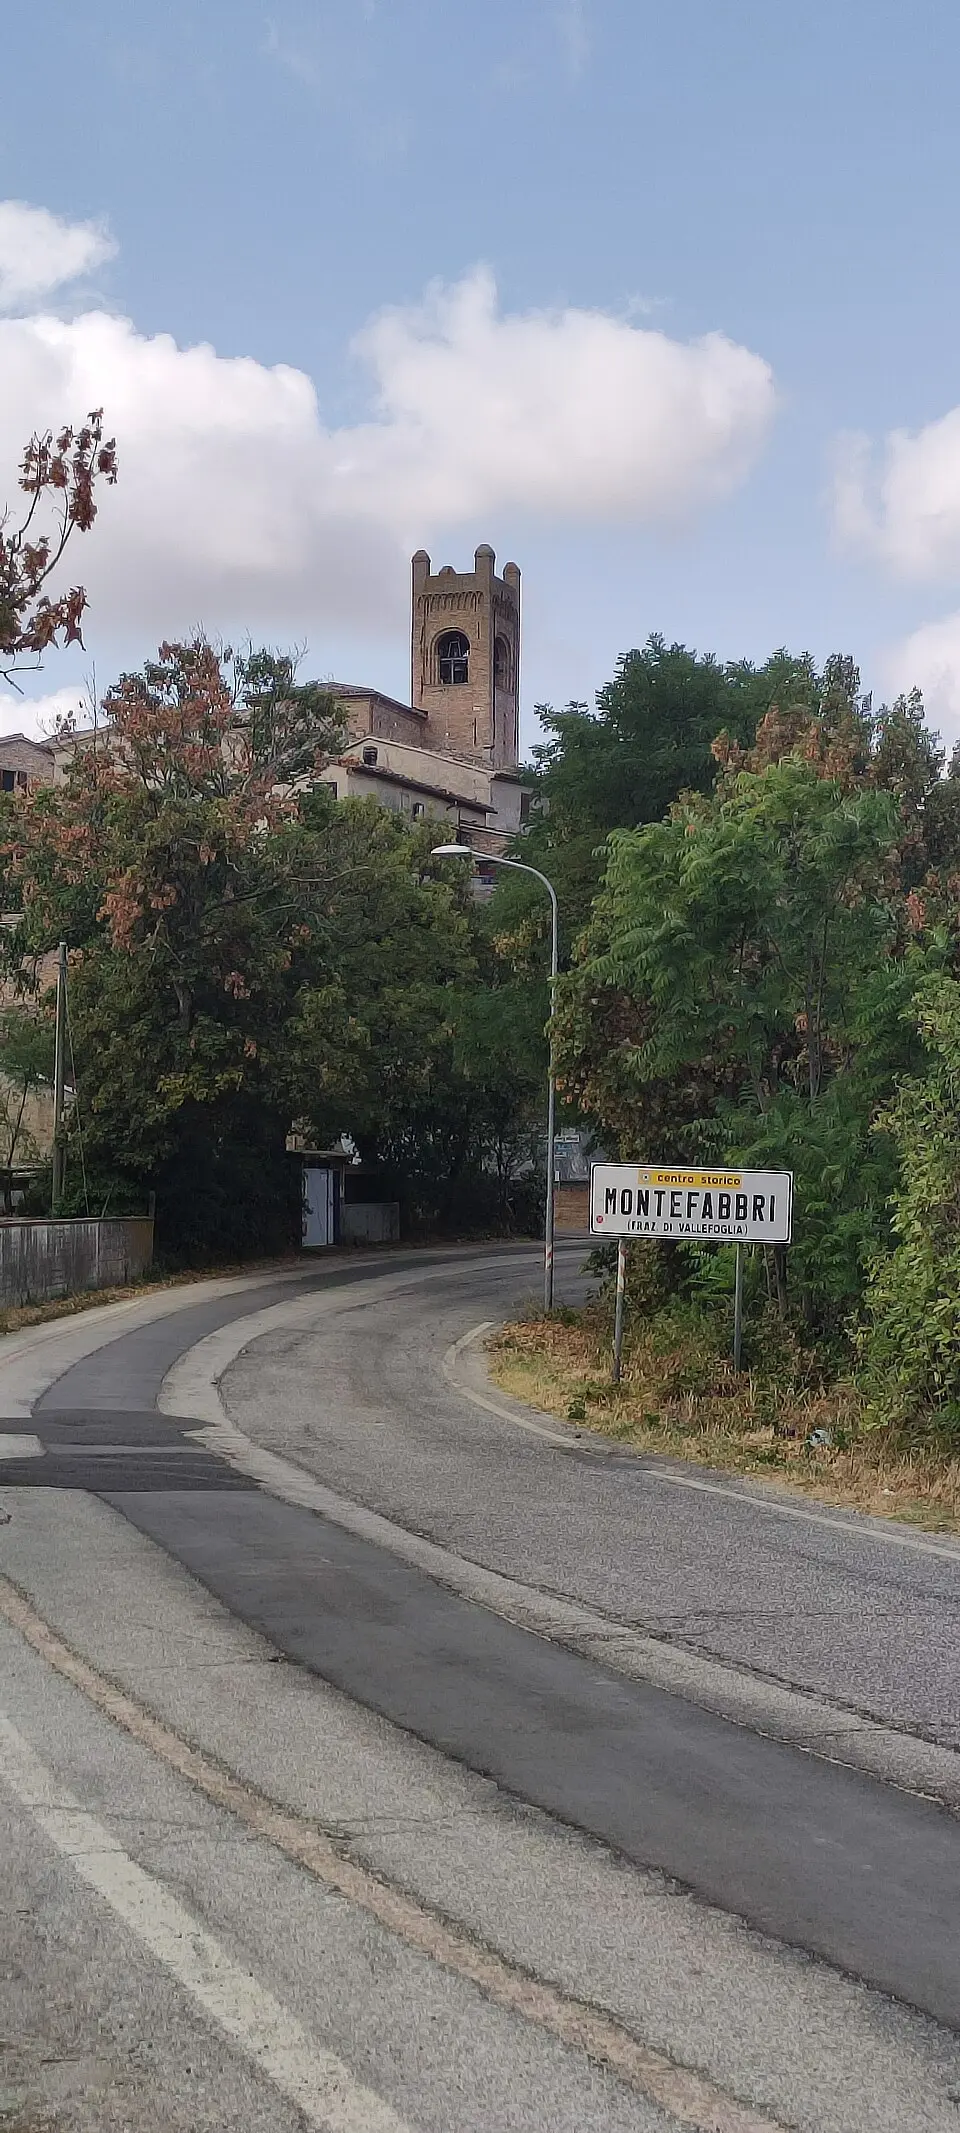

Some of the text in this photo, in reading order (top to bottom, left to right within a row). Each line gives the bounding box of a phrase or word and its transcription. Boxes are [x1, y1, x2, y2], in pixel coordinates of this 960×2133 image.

[657, 1174, 741, 1186] centro storico
[604, 1187, 775, 1222] MONTEFABBRI
[663, 1223, 673, 1232] DI
[679, 1223, 748, 1236] VALLEFOGLIA)
